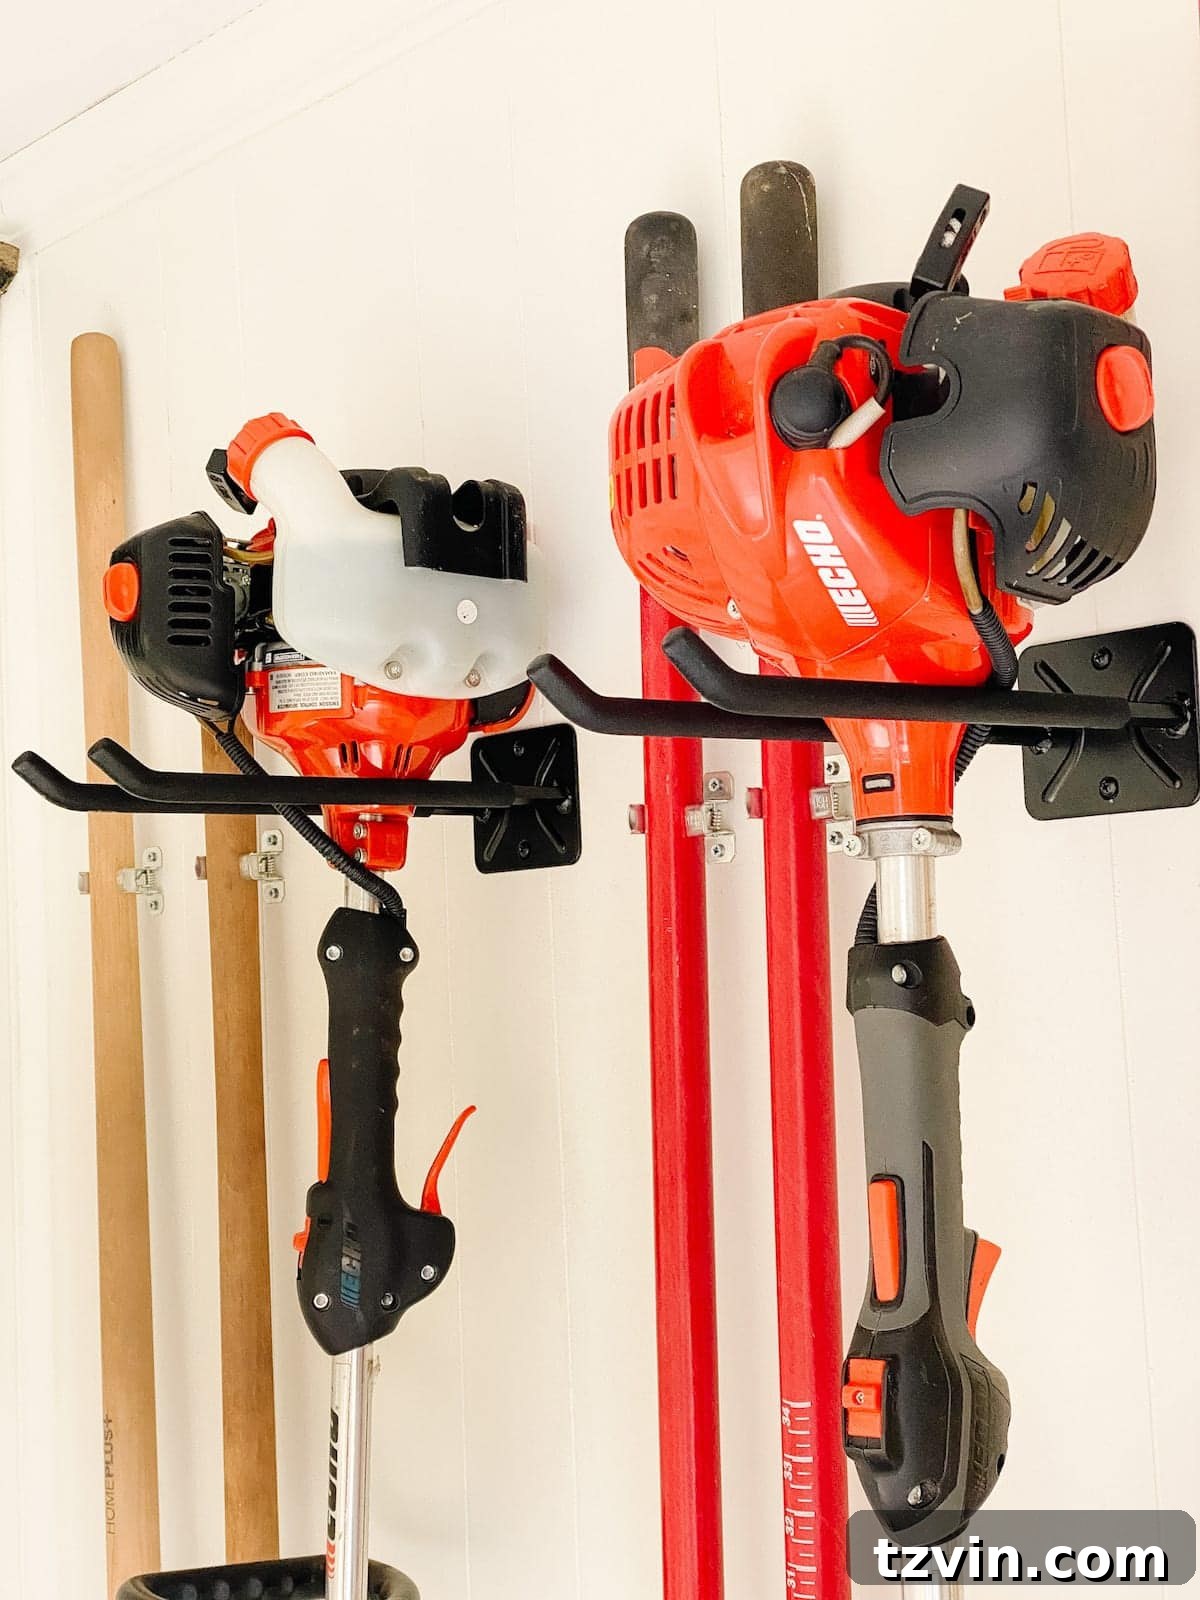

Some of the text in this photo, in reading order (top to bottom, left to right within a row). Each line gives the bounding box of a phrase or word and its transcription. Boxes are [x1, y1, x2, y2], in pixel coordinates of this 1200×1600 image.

[792, 519, 880, 627] ECHO
[782, 1406, 791, 1427] 34
[783, 1460, 793, 1481] 33
[785, 1515, 795, 1537] 32
[786, 1569, 796, 1589] 31
